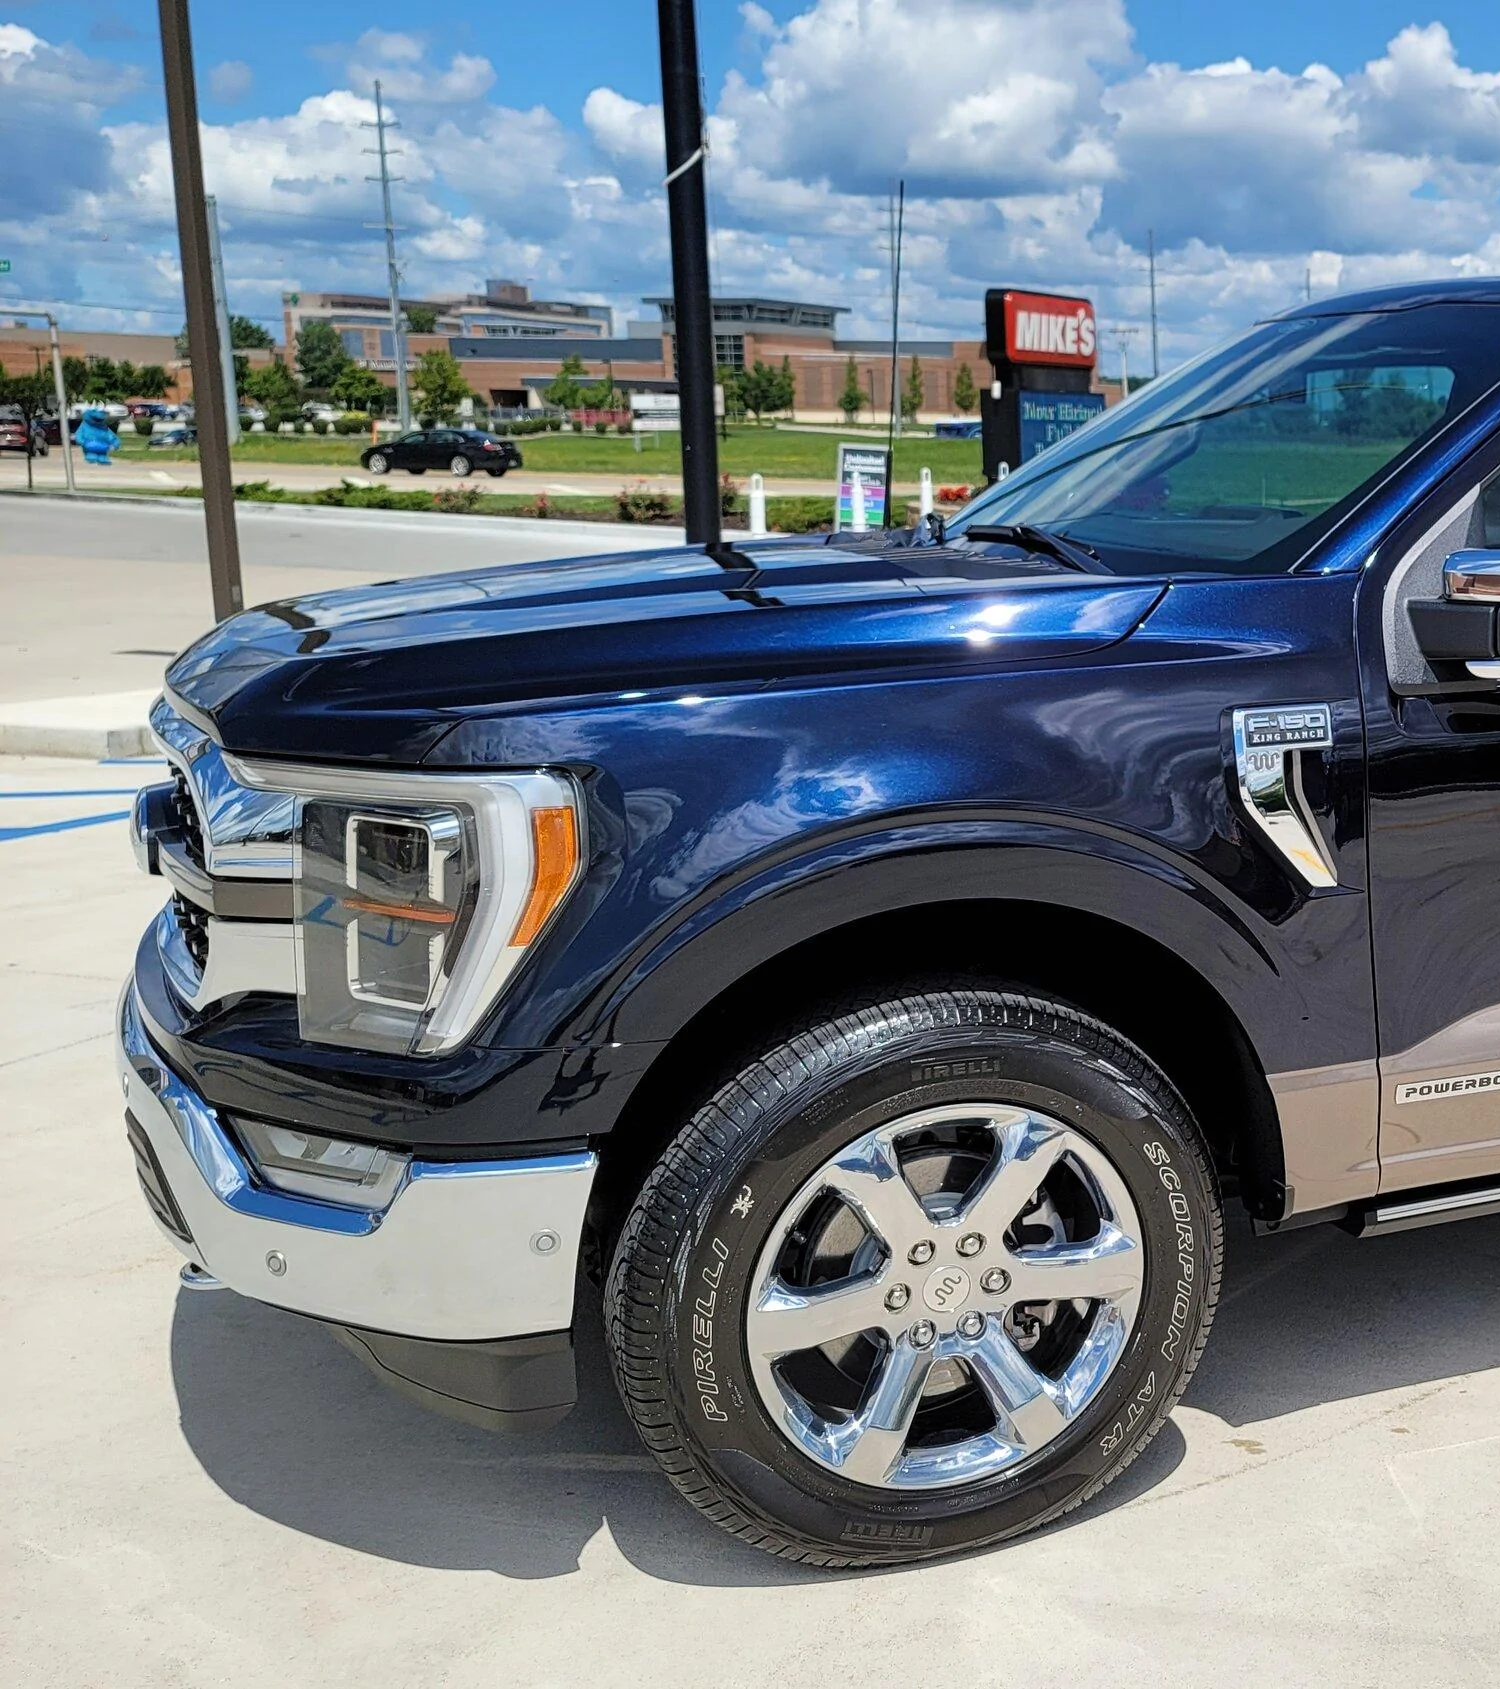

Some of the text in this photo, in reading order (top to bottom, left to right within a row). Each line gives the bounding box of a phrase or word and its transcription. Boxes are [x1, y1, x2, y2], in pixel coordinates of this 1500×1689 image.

[1015, 308, 1095, 357] MIKE'S
[1252, 729, 1325, 743] KING RANCH
[910, 1055, 1000, 1082] PIRELLI
[1100, 1141, 1195, 1456] SCORPION ATR
[692, 1237, 729, 1422] PIRELLI
